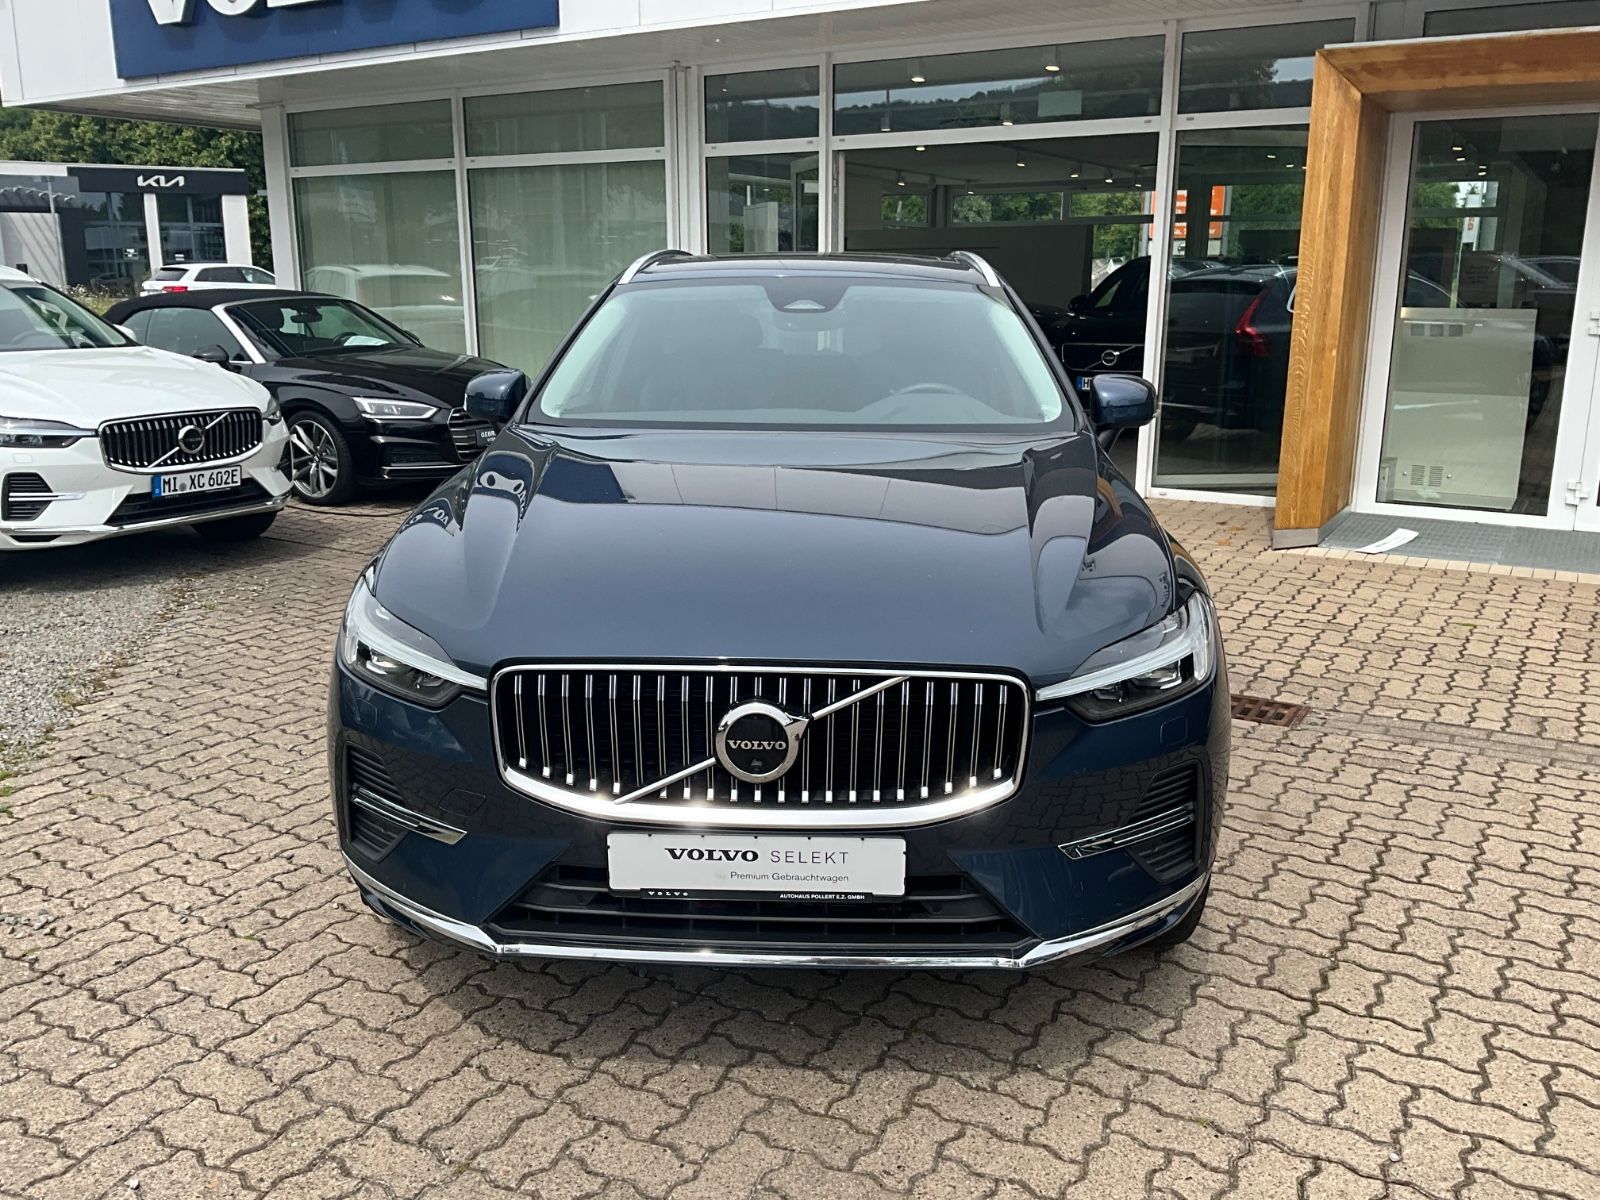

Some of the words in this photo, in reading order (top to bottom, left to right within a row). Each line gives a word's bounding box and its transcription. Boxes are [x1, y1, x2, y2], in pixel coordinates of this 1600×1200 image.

[162, 477, 178, 493] MI
[189, 473, 205, 490] XC
[208, 469, 239, 487] 602E
[727, 739, 787, 750] VOLVO
[664, 847, 759, 862] VOLVO
[770, 850, 849, 864] SELEKT
[730, 871, 769, 881] Premium
[771, 872, 849, 883] Gebrauchtwagen
